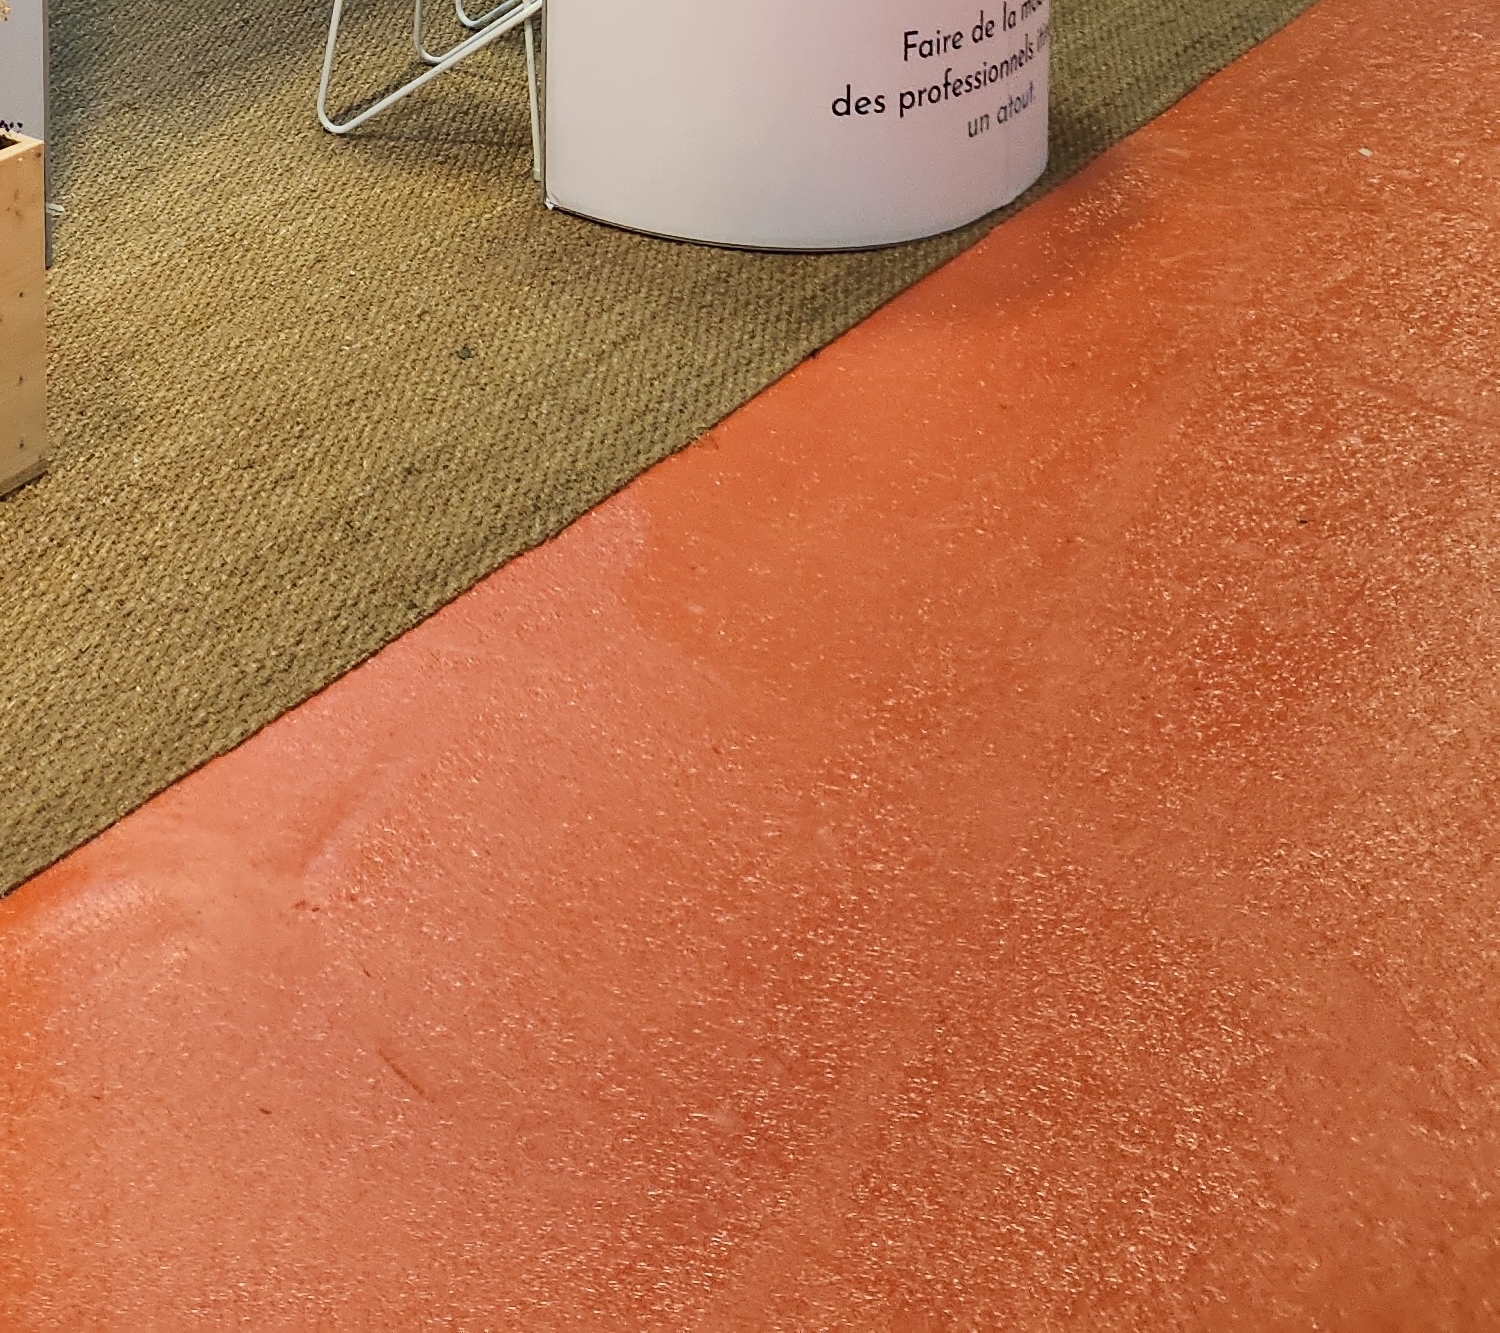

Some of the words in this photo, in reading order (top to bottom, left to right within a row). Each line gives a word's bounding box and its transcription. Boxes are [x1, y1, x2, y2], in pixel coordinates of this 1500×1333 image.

[903, 30, 963, 61] Faire
[971, 10, 995, 43] de
[1003, 0, 1016, 31] la
[831, 84, 885, 116] des
[899, 33, 1034, 118] professionnels
[967, 113, 990, 138] un
